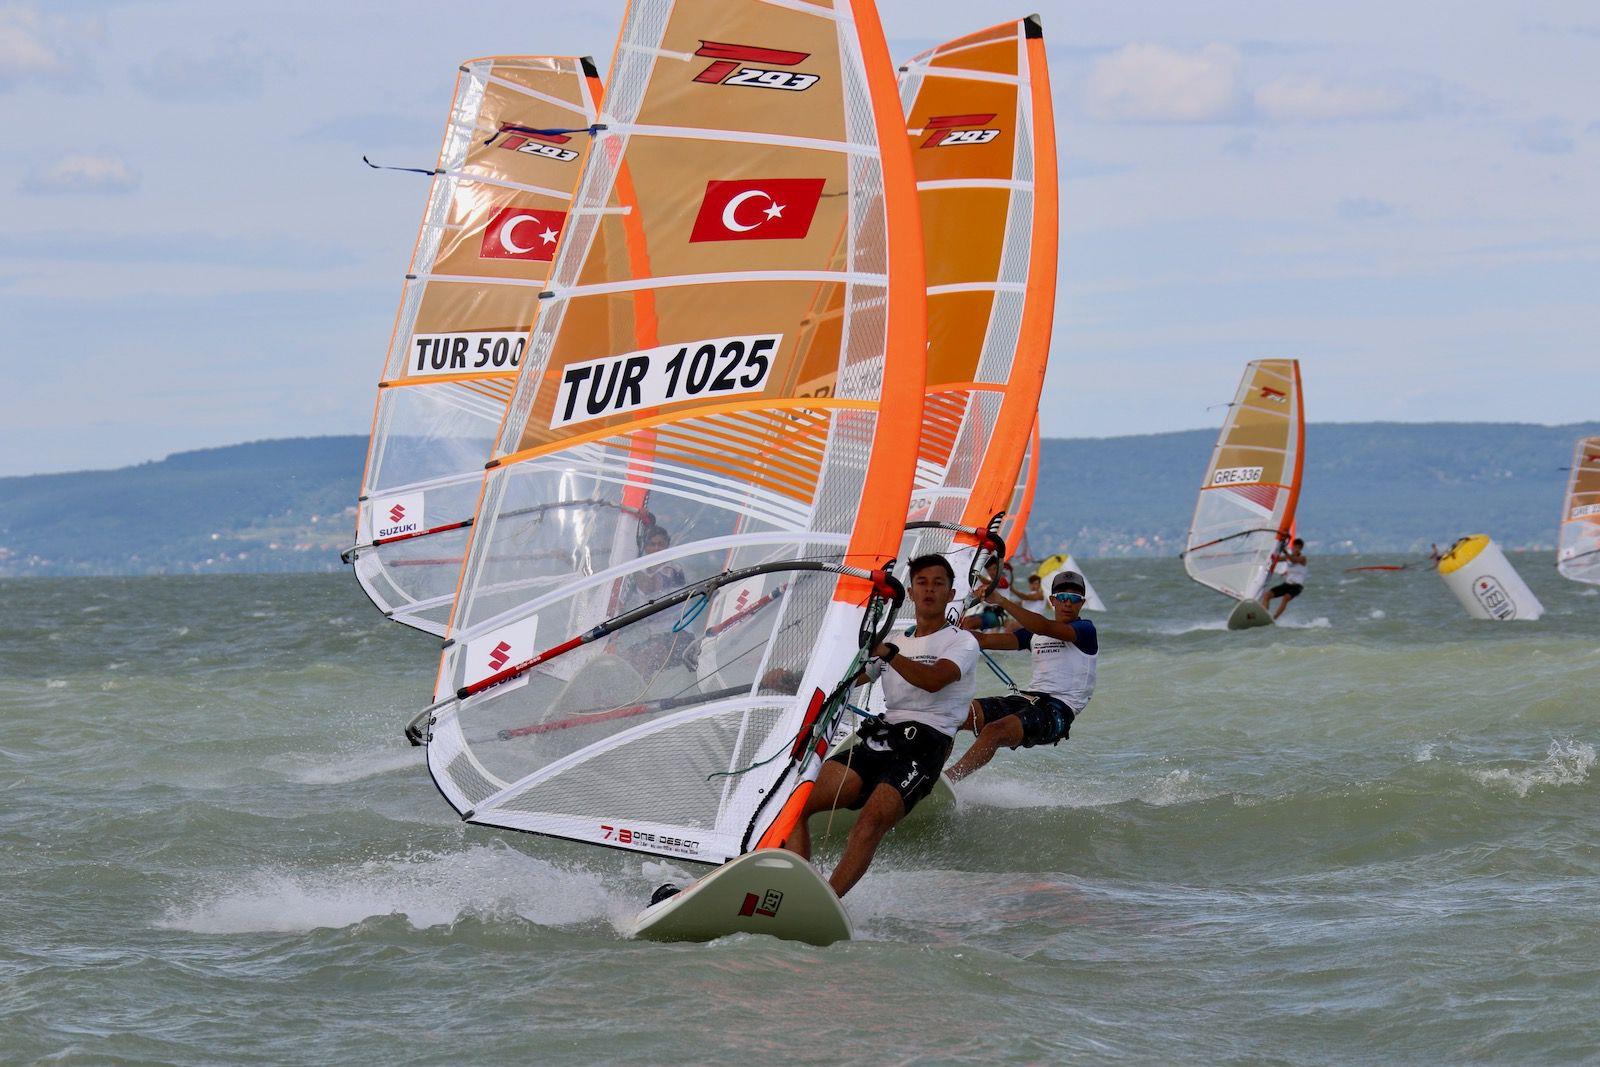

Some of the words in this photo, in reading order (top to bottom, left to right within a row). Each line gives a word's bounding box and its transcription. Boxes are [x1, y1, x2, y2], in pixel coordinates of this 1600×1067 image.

[416, 338, 469, 371] TUR
[563, 356, 650, 421] TUR
[664, 339, 776, 398] 1025
[379, 523, 417, 537] SUZUKI
[601, 825, 632, 844] 7.8
